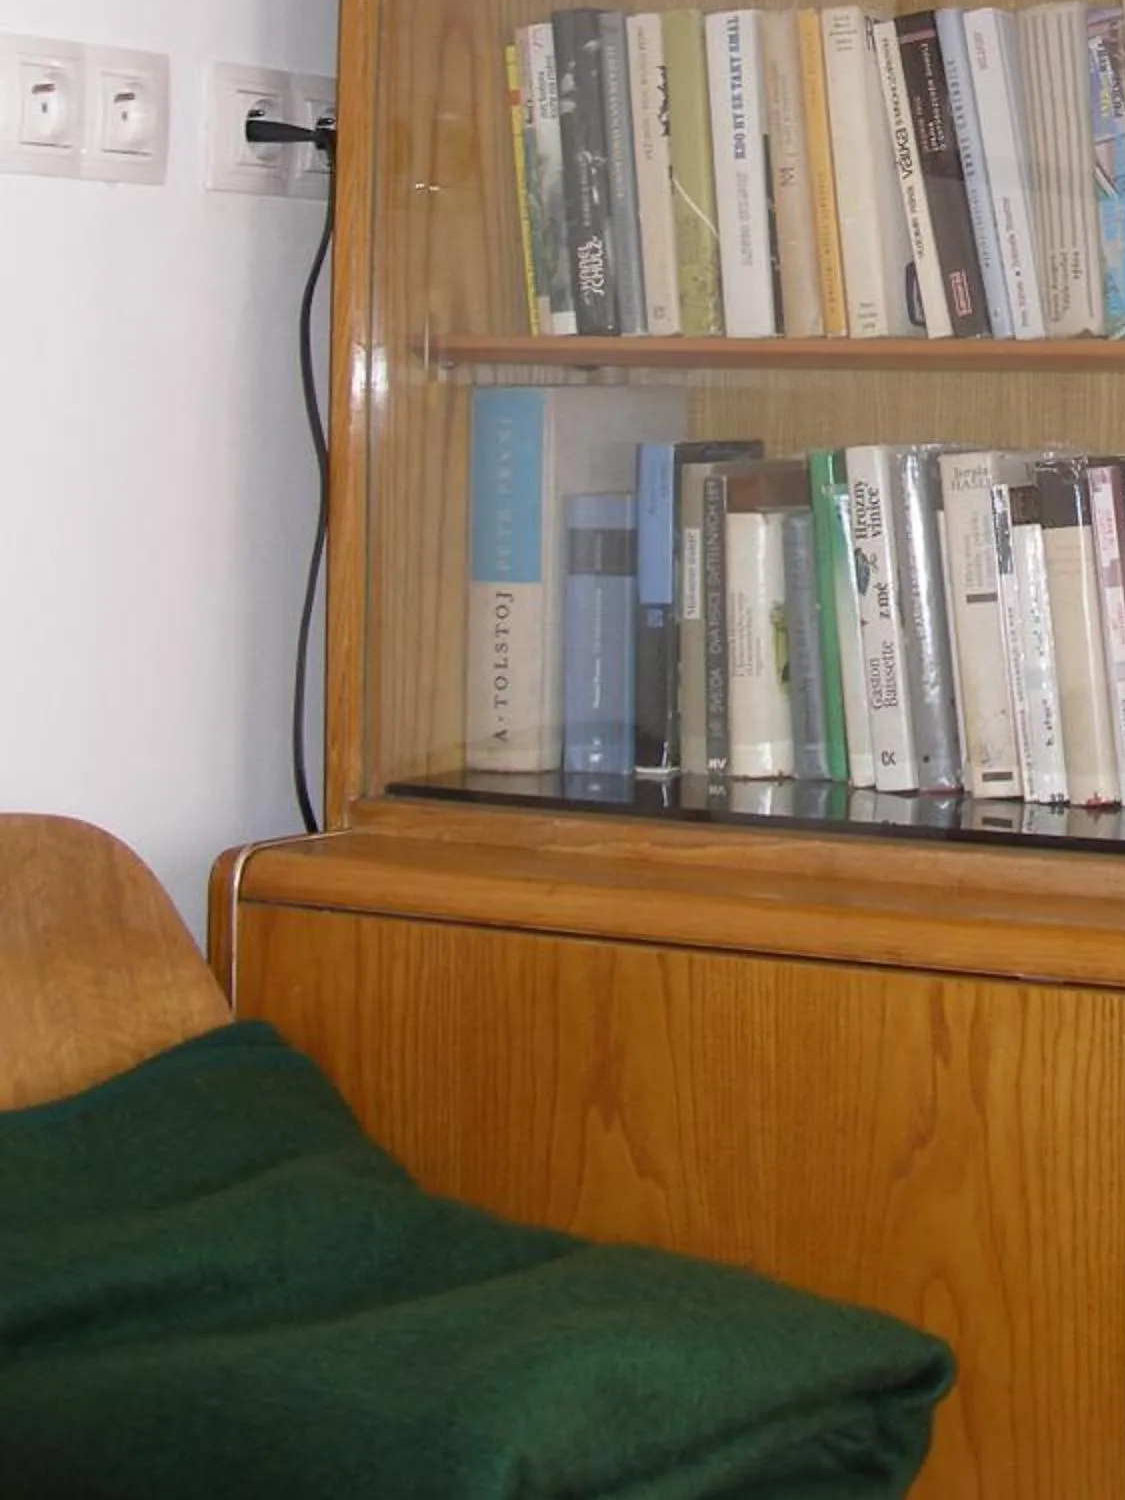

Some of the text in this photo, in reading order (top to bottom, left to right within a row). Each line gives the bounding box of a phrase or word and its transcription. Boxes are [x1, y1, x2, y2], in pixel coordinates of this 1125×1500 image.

[853, 479, 872, 540] Hrozny
[867, 486, 883, 538] vinice
[874, 582, 890, 609] mé
[493, 591, 514, 706] TOLSTOJ
[868, 657, 883, 710] Gaston
